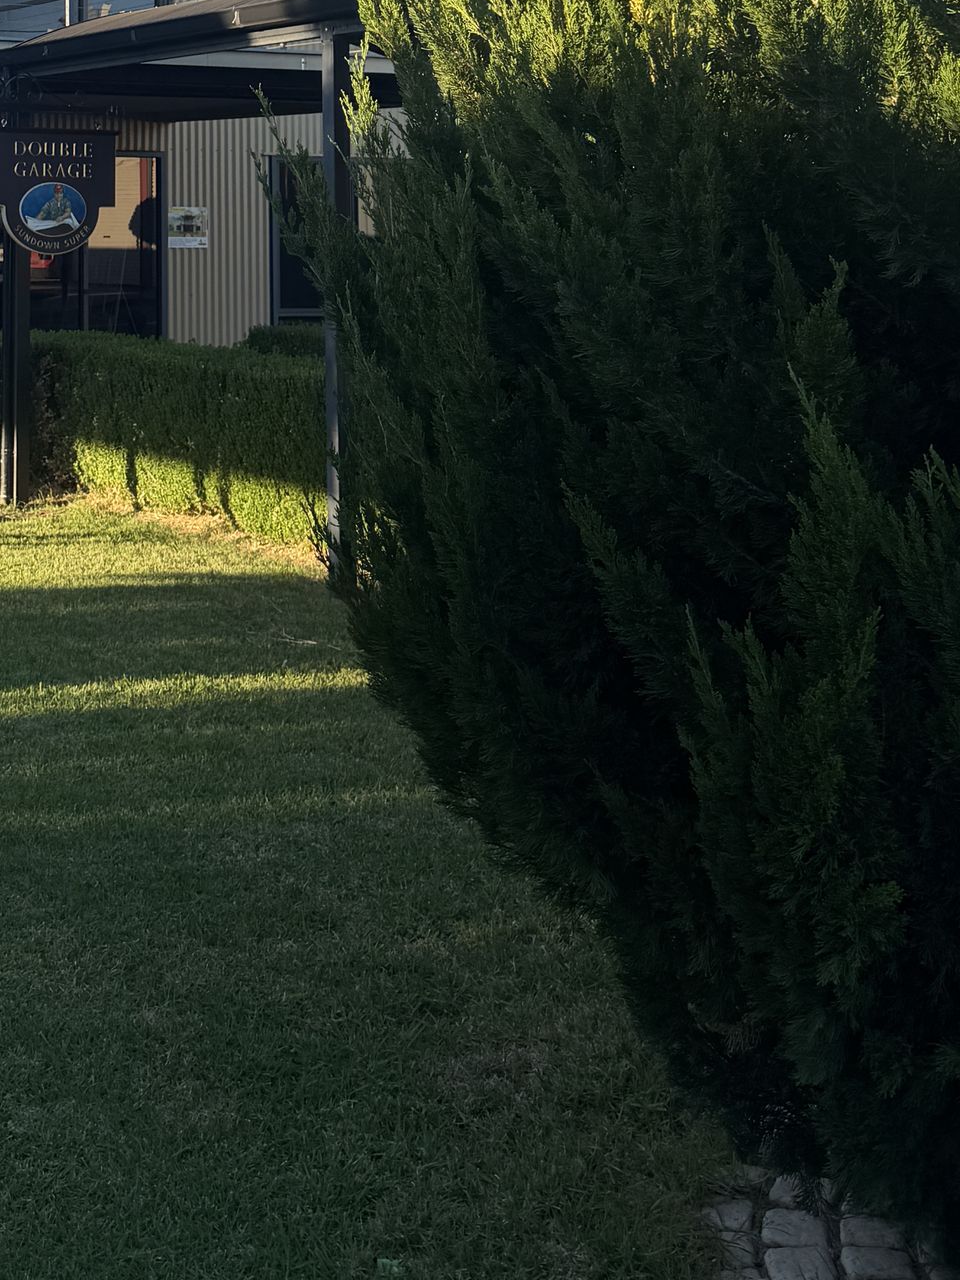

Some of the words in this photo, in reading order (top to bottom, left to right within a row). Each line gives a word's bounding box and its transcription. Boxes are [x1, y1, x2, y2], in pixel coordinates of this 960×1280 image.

[13, 141, 93, 158] DOUBLE
[13, 162, 93, 179] GARAGE
[14, 224, 61, 250] SUNDOWN
[64, 225, 92, 247] SUPER
